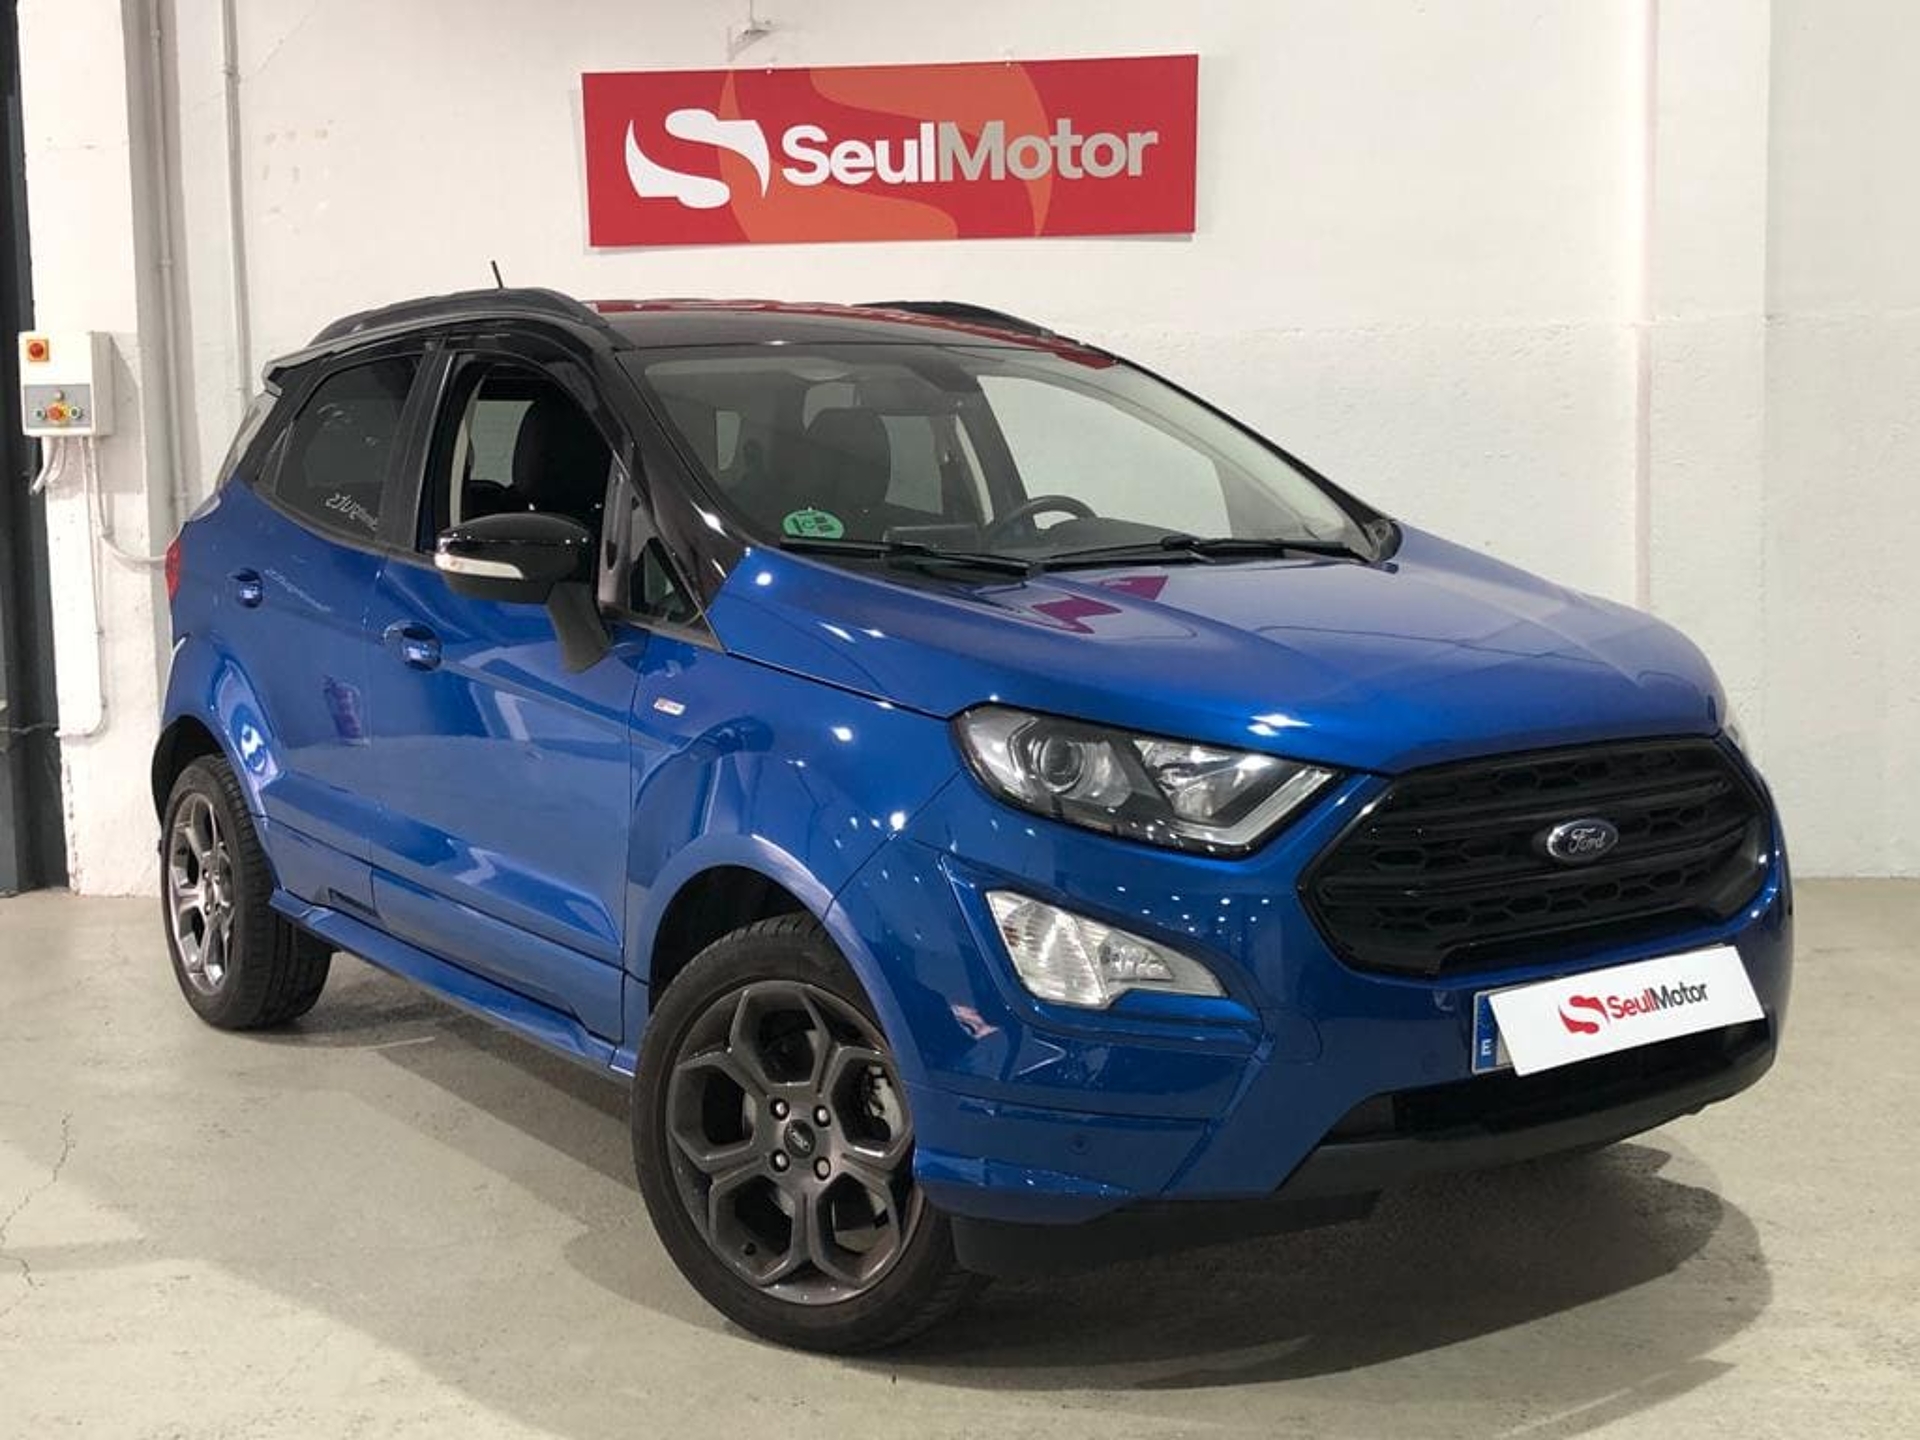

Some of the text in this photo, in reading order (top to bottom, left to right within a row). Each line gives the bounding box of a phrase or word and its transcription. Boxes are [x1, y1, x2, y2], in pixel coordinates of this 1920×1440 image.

[782, 118, 1158, 186] SeulMotor
[1569, 828, 1605, 853] Ford
[1607, 982, 1708, 1019] SeulMotor
[1481, 1039, 1491, 1055] E
